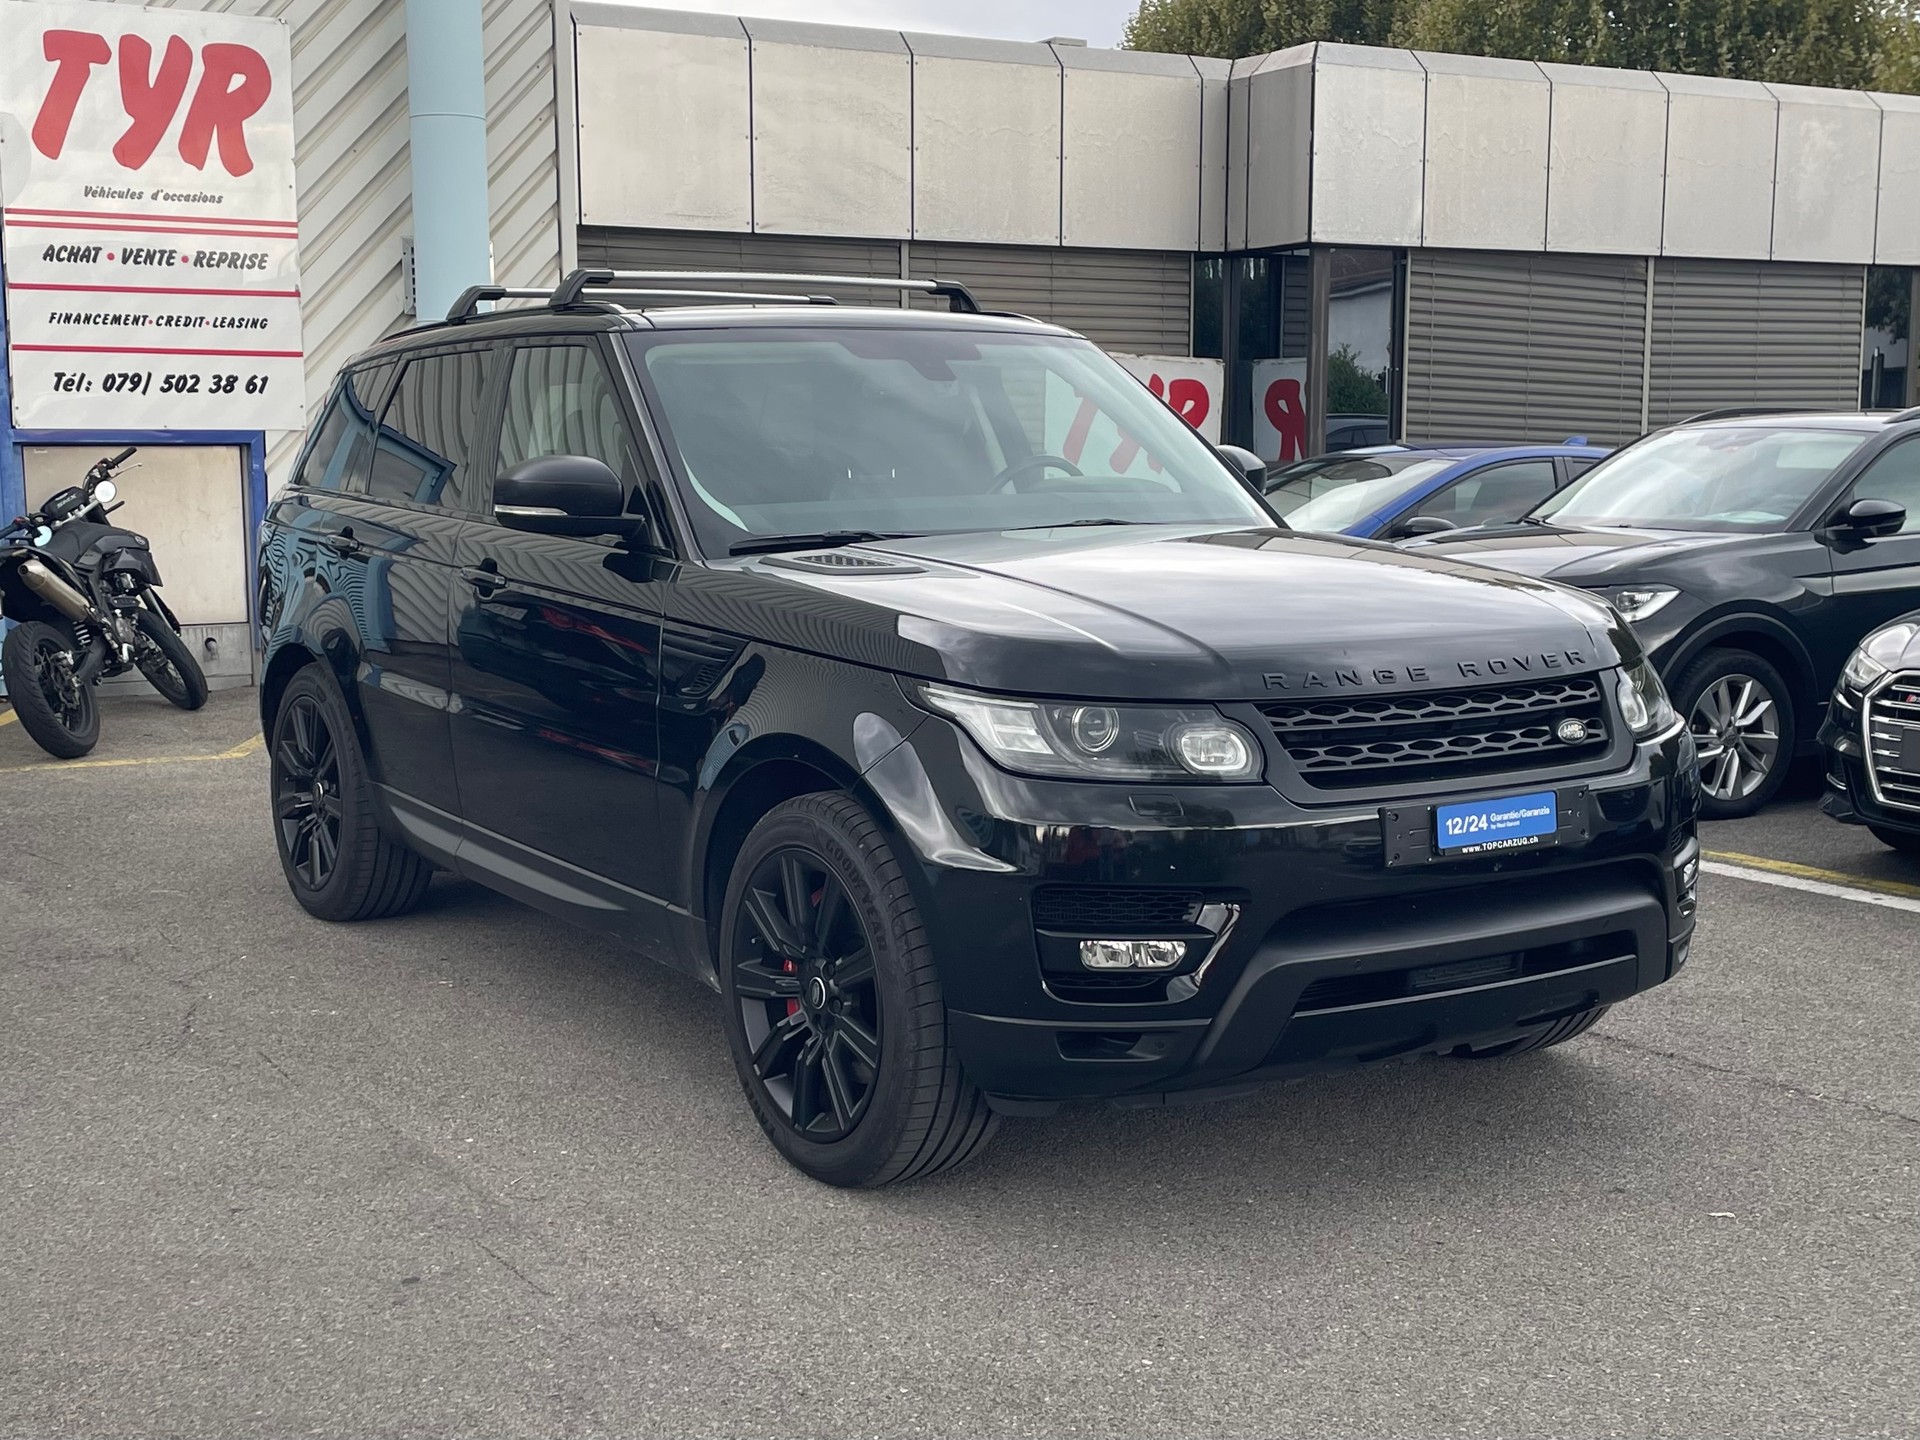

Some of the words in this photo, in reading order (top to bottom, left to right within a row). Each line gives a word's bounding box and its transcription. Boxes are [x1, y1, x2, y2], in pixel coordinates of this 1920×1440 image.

[31, 29, 272, 178] TYR
[83, 185, 144, 201] Véhicules
[150, 188, 224, 205] d'occasions
[42, 244, 103, 264] ACHAT
[120, 247, 178, 267] VENTE
[193, 250, 269, 270] REPRISE
[48, 311, 149, 327] FINANCEMENT
[155, 315, 206, 329] CREDIT
[212, 316, 269, 330] LEASING
[53, 372, 93, 393] Tél:
[159, 374, 201, 394] 502
[208, 374, 239, 394] 38
[244, 375, 270, 395] 61
[1262, 666, 1430, 691] RANGE
[1457, 649, 1587, 678] ROVER
[1445, 814, 1488, 835] 12/24
[1462, 836, 1539, 853] www.TOPCARZUG.ch
